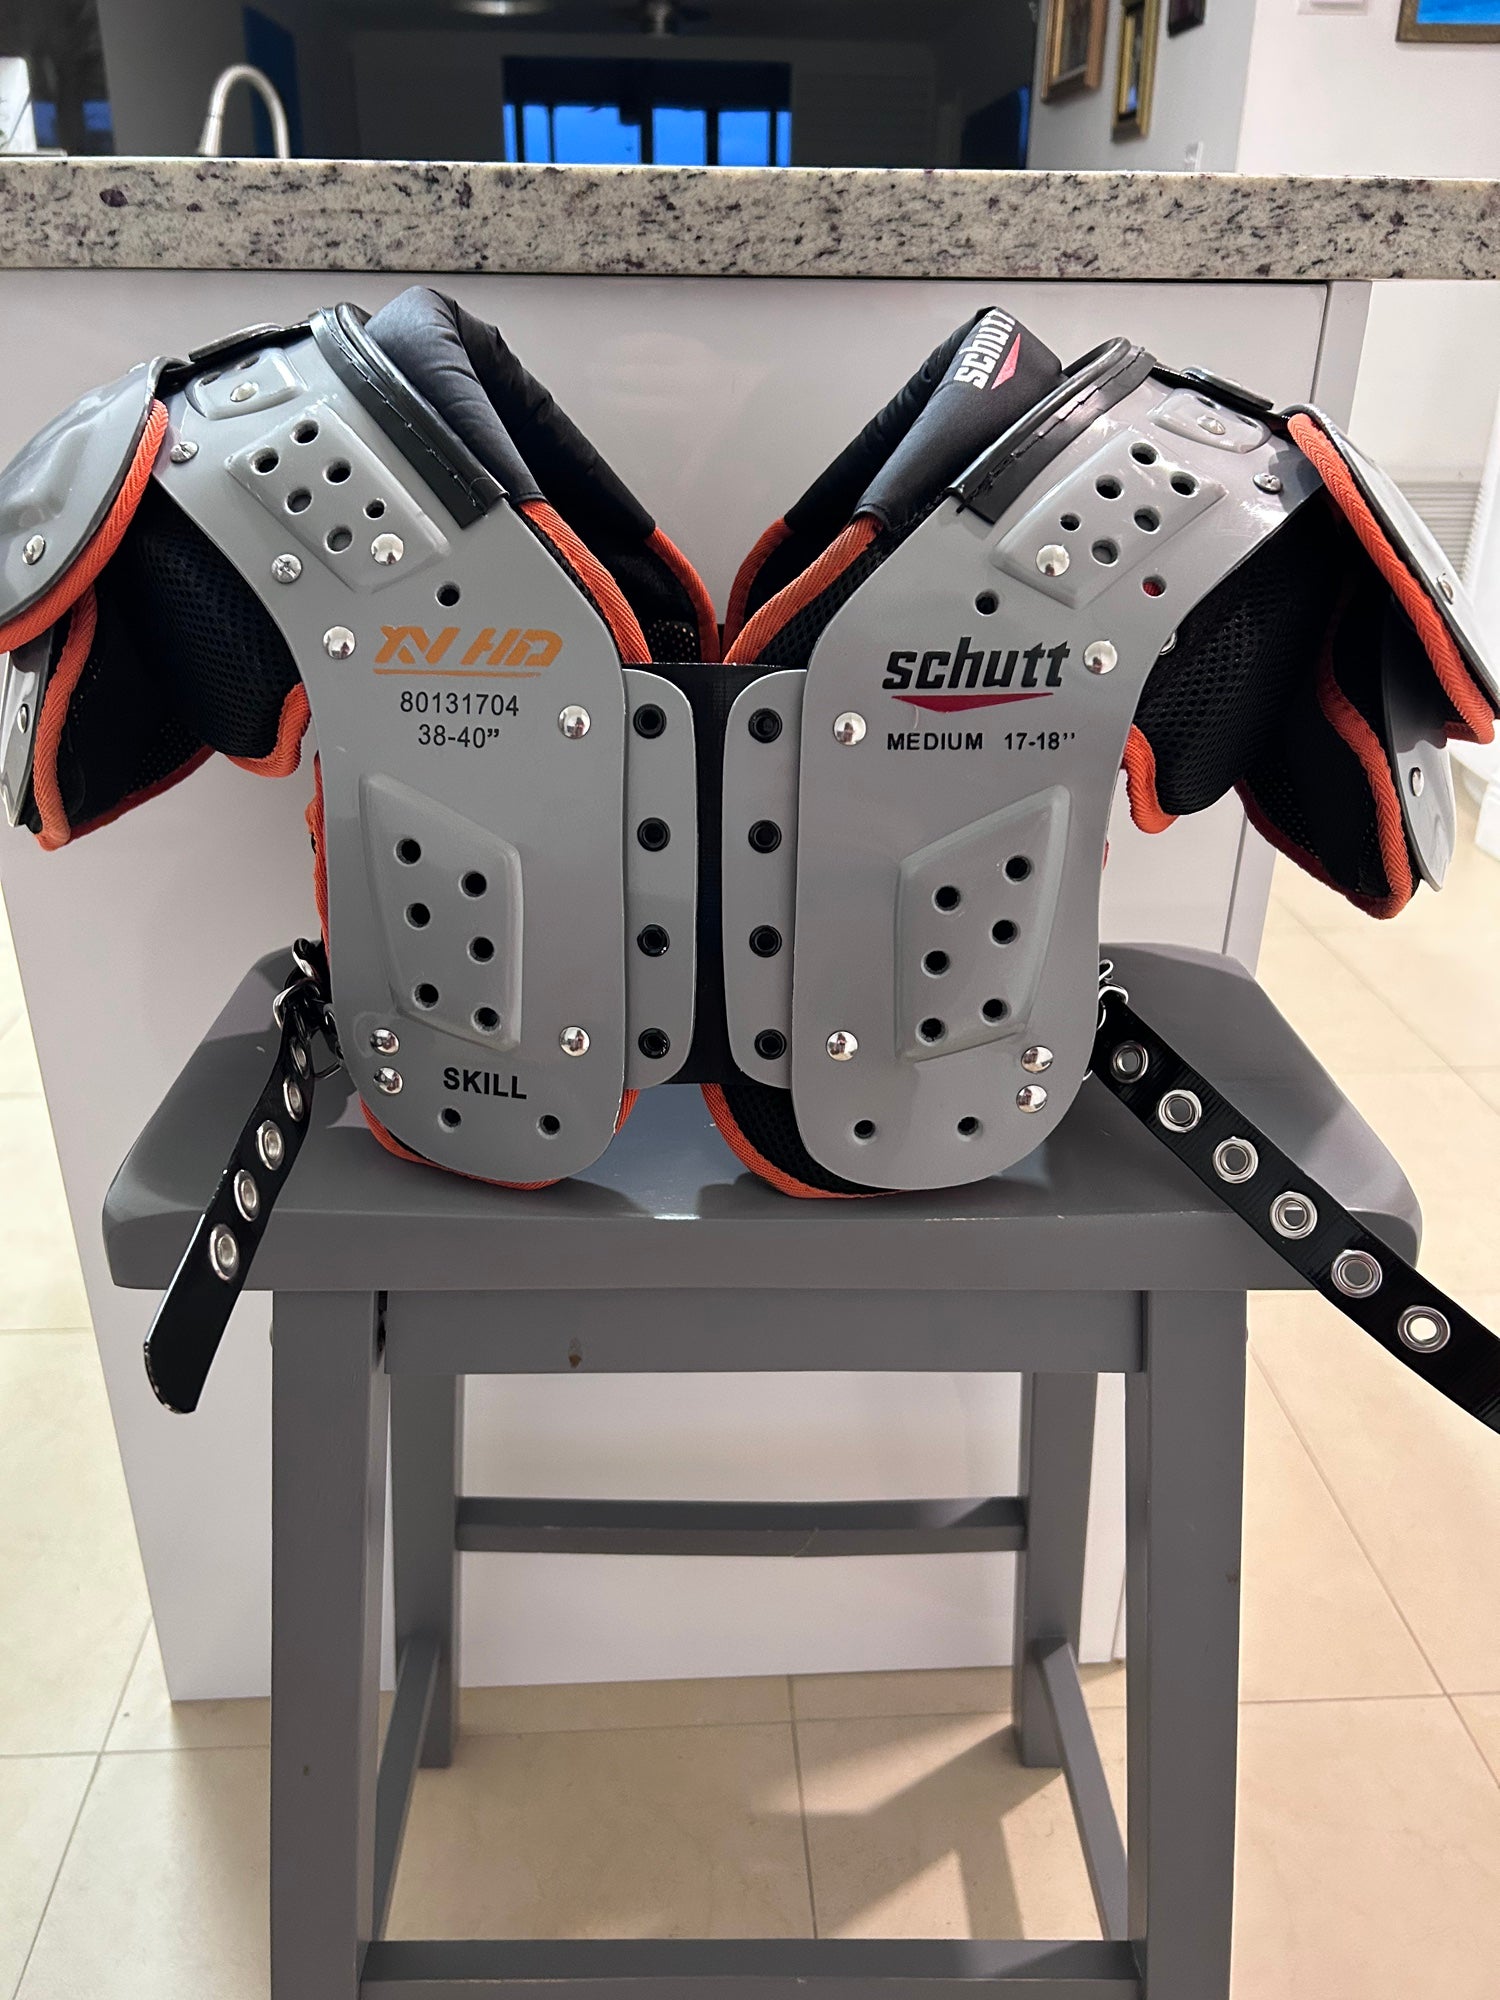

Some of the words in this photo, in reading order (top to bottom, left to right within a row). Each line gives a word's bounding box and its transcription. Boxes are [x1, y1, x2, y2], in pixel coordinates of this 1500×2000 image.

[953, 309, 1015, 390] schutt
[460, 628, 564, 668] HD
[400, 690, 520, 717] 80131704
[887, 732, 984, 751] MEDIUM
[443, 1066, 528, 1100] SKILL
